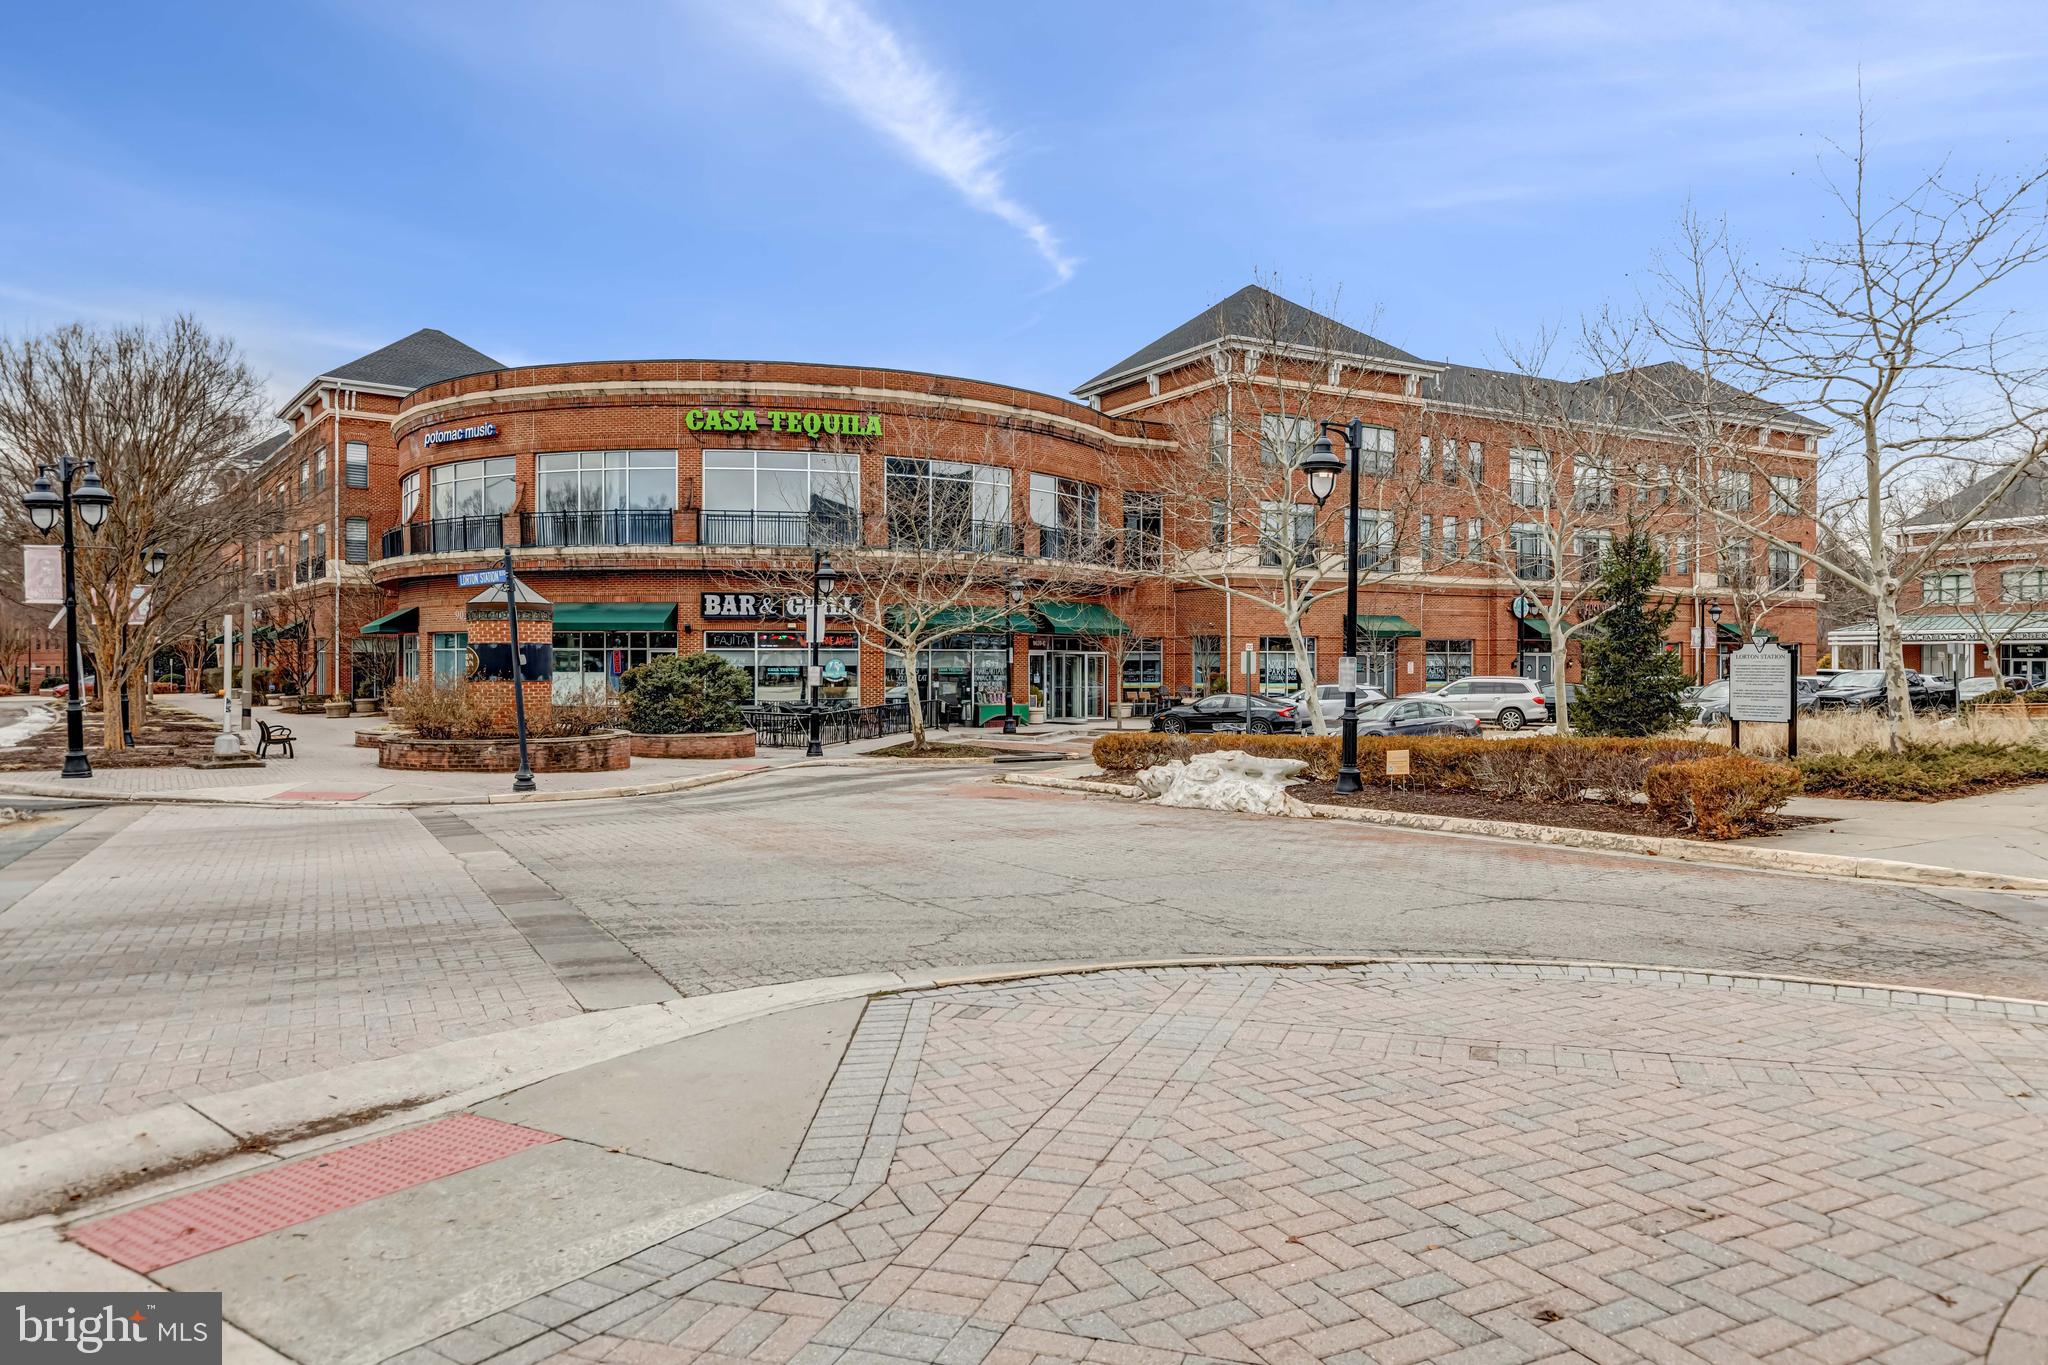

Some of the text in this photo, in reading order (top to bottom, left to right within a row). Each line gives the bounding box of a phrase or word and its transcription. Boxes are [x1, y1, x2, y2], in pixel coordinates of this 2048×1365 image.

[685, 409, 883, 438] CASA TEQUILA
[424, 422, 494, 448] potomac music
[460, 572, 479, 585] LORTON
[704, 595, 756, 616] BAR
[1267, 668, 1297, 677] PARKNG
